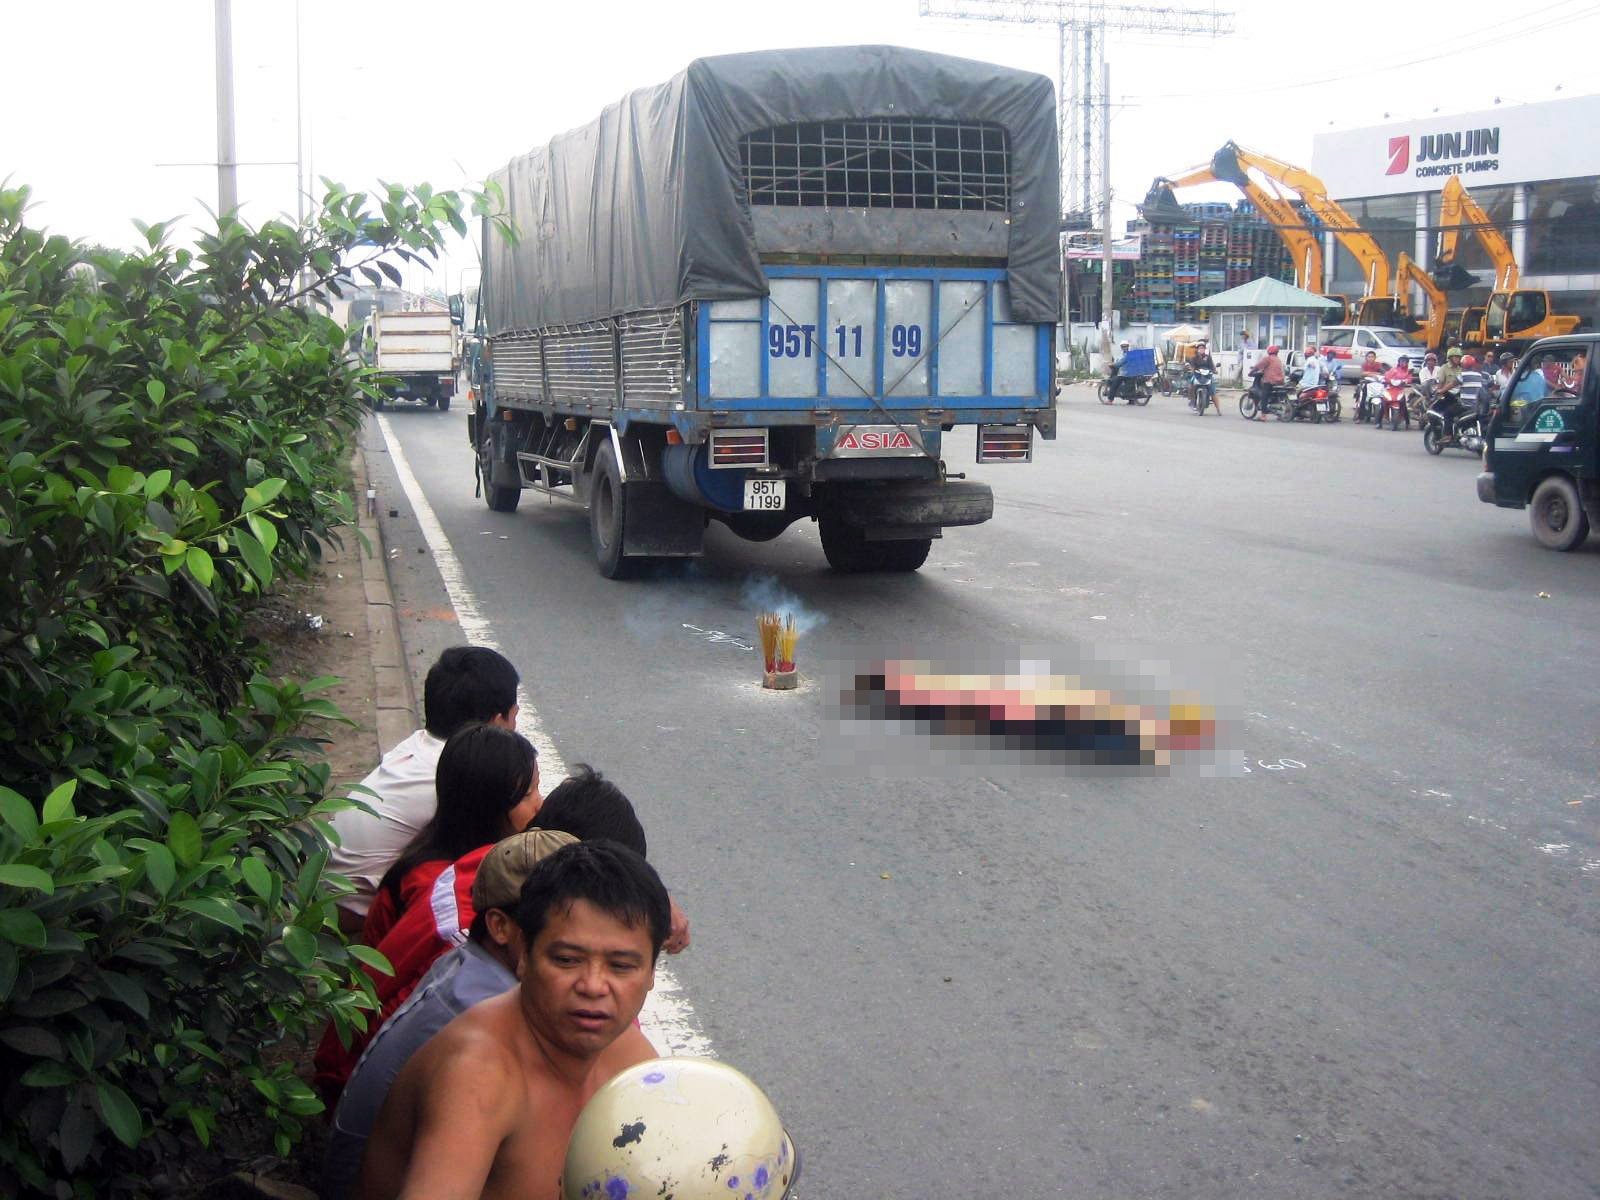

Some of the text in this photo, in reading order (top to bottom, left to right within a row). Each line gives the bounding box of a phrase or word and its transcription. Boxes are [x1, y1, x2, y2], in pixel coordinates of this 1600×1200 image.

[1416, 127, 1499, 162] JUNJIN
[1416, 159, 1499, 178] CONCRETE PUMPS
[769, 324, 922, 358] 95T 11 99
[837, 431, 914, 450] ASIA
[752, 481, 778, 494] 95T
[750, 495, 782, 508] 1199
